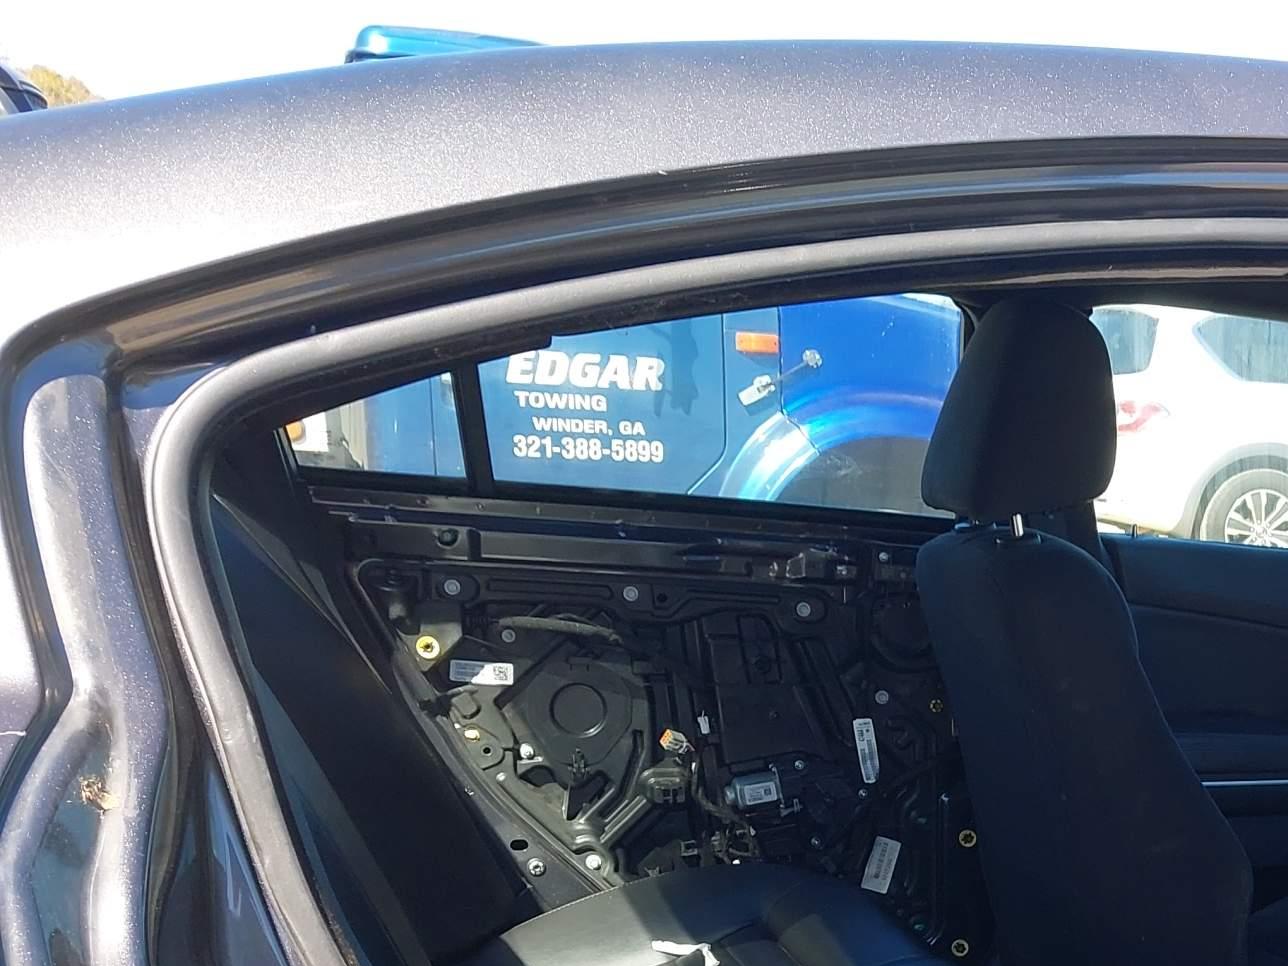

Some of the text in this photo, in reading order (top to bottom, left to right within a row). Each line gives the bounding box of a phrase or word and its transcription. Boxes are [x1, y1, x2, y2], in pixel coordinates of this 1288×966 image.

[505, 350, 665, 390] EDGAR
[513, 390, 607, 411] TOWING
[532, 416, 646, 436] WINDER, GA
[513, 434, 664, 463] 321-388-5899
